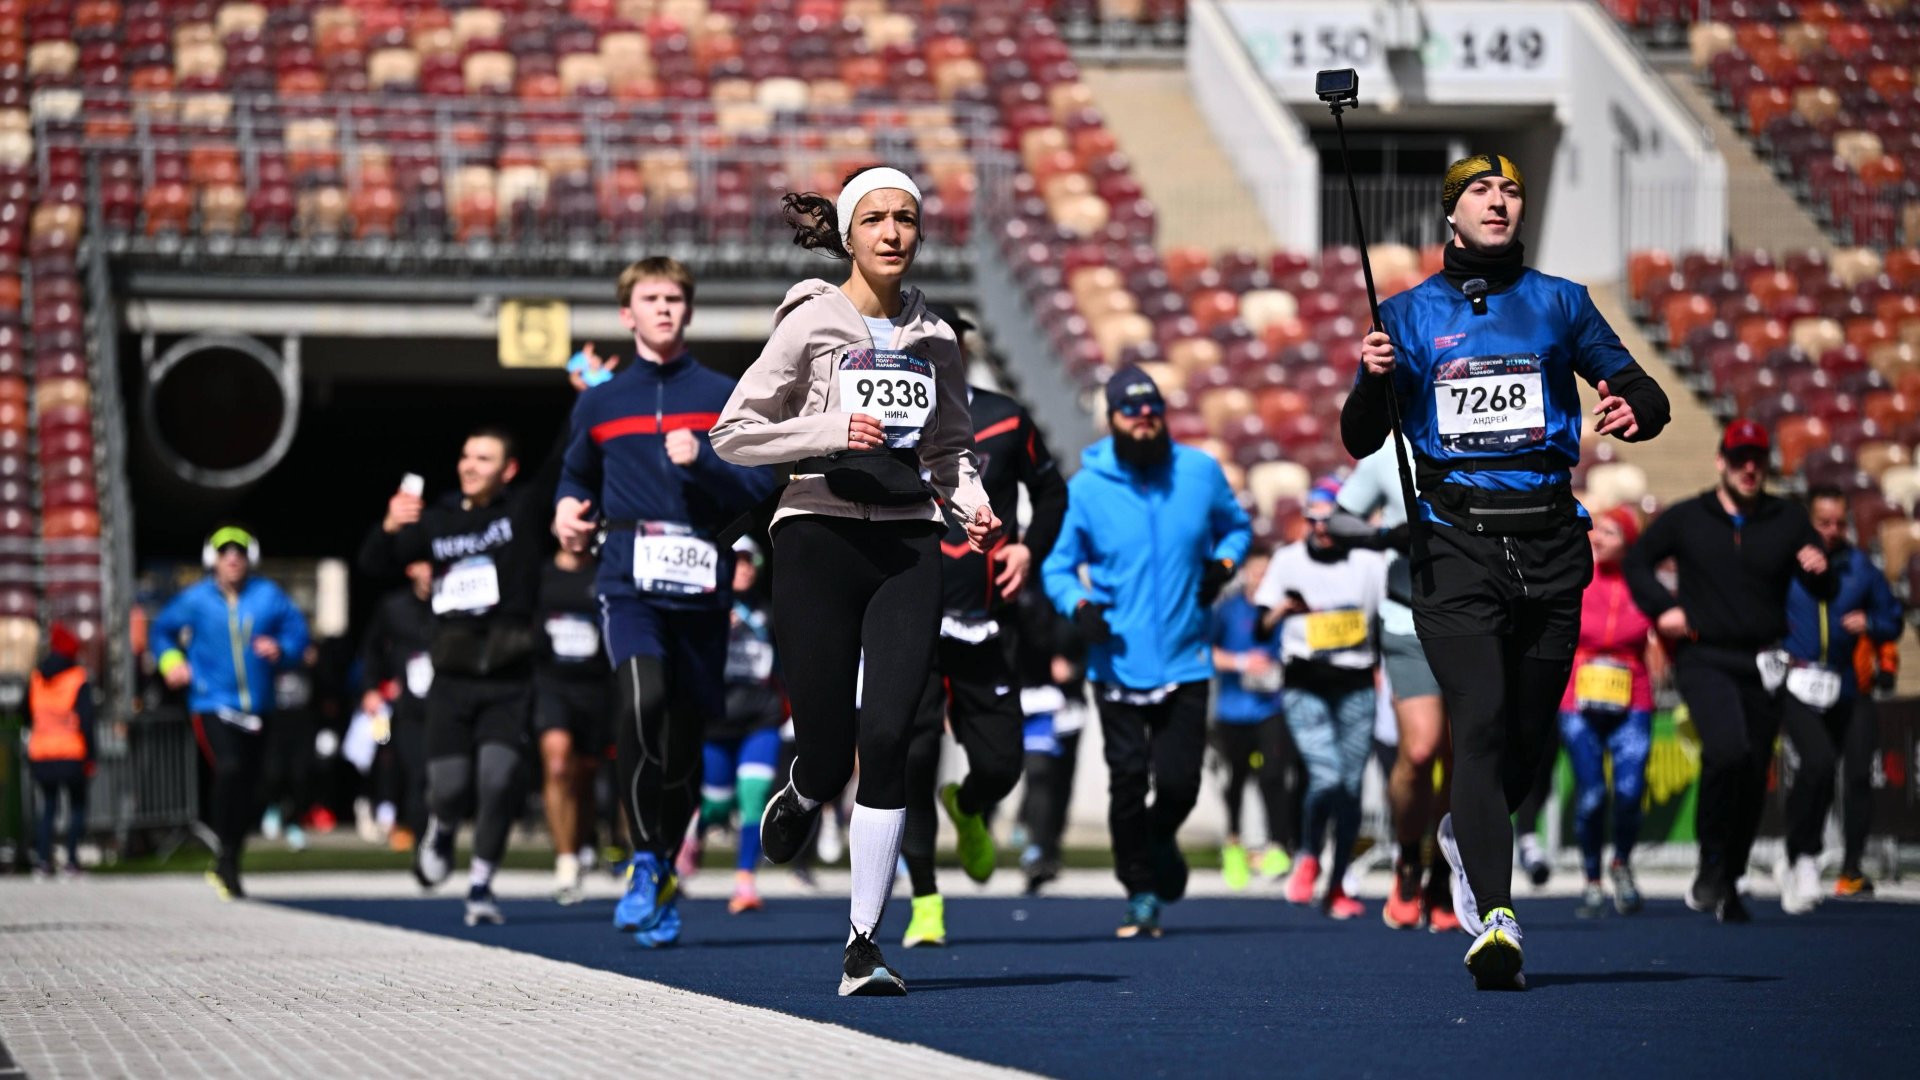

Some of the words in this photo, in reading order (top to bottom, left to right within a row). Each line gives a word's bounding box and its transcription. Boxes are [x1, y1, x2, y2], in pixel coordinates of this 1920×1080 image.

[1287, 26, 1372, 68] 150
[1459, 26, 1545, 69] 149
[856, 378, 929, 409] 9338
[1450, 383, 1527, 415] 7268
[884, 410, 909, 419] НИНА
[1472, 415, 1508, 425] АНДРЕЙ
[644, 545, 711, 570] 14384
